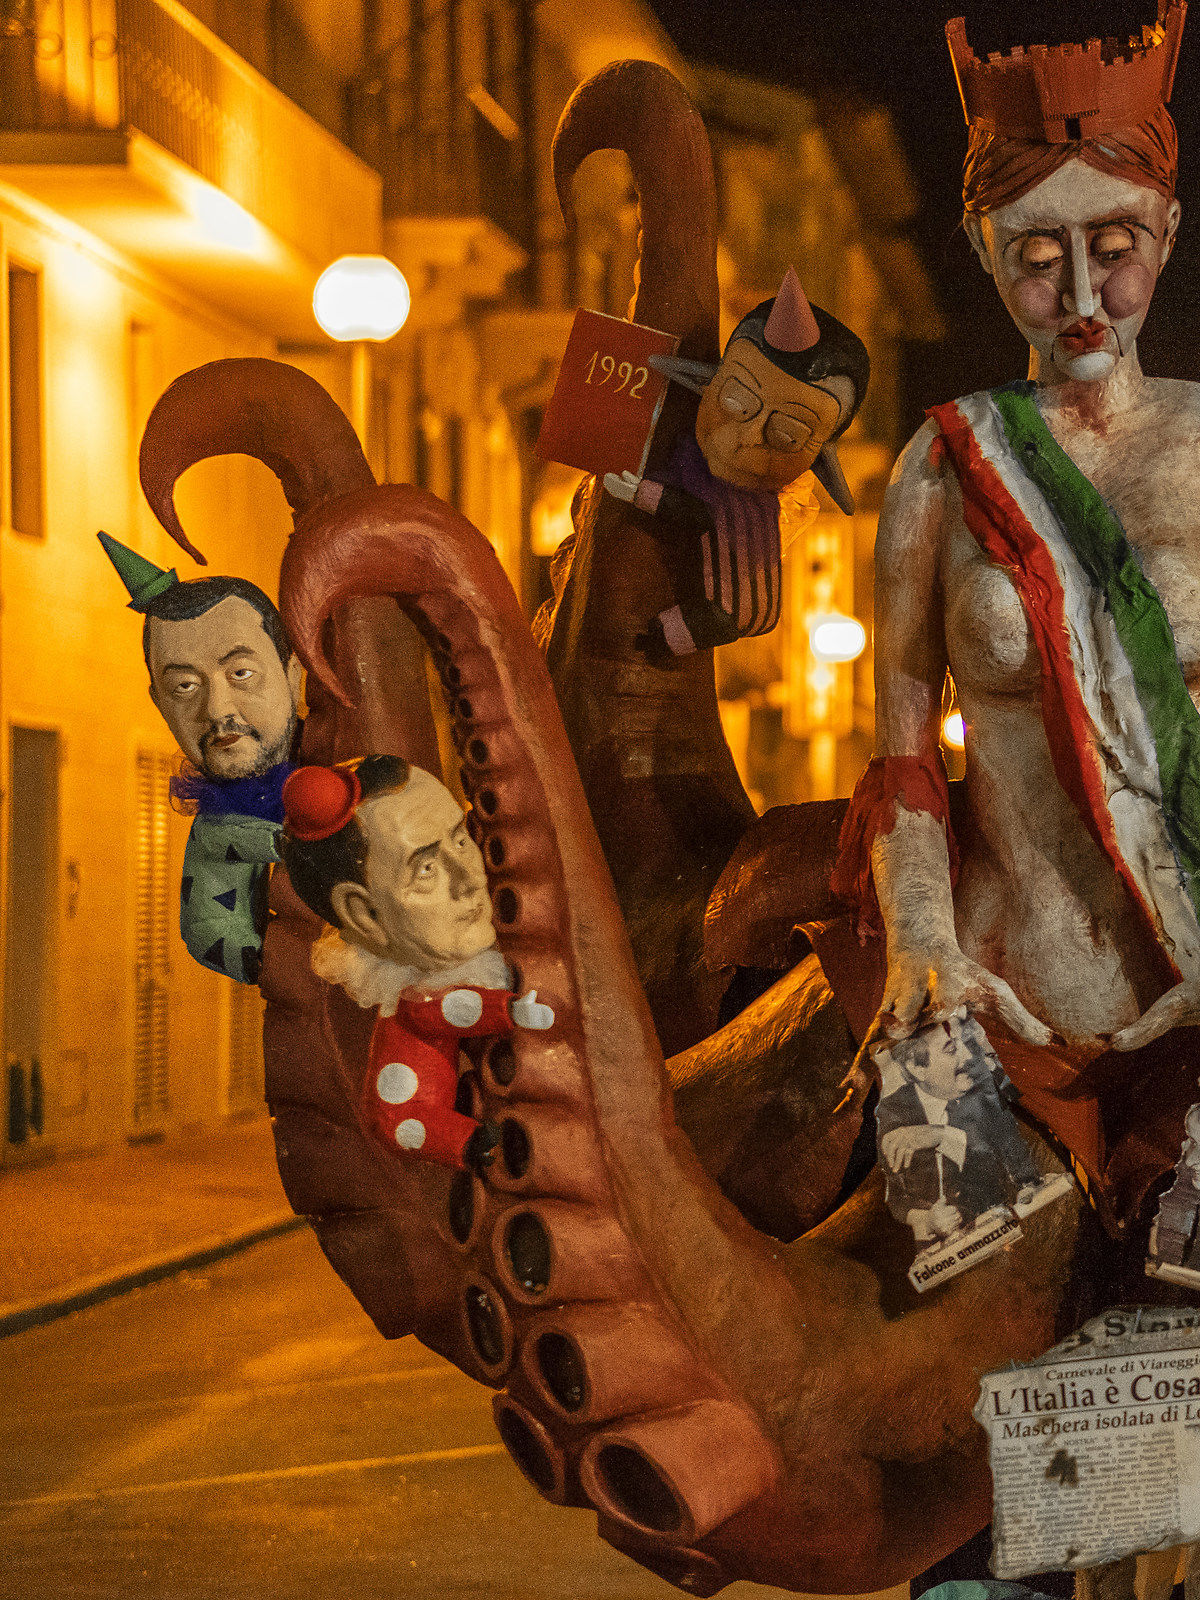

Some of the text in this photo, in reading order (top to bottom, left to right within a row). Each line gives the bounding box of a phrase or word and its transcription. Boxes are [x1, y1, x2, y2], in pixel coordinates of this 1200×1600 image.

[585, 350, 649, 400] 1992
[913, 1219, 1019, 1284] Falcone ammazzato
[1046, 1364, 1116, 1382] Carnevale
[1120, 1361, 1135, 1374] di
[991, 1382, 1095, 1416] L'Italia
[1105, 1377, 1120, 1404] è
[1130, 1374, 1200, 1402] Cosa
[1001, 1415, 1089, 1440] Maschera
[1096, 1411, 1154, 1430] isolata
[1160, 1405, 1178, 1422] di
